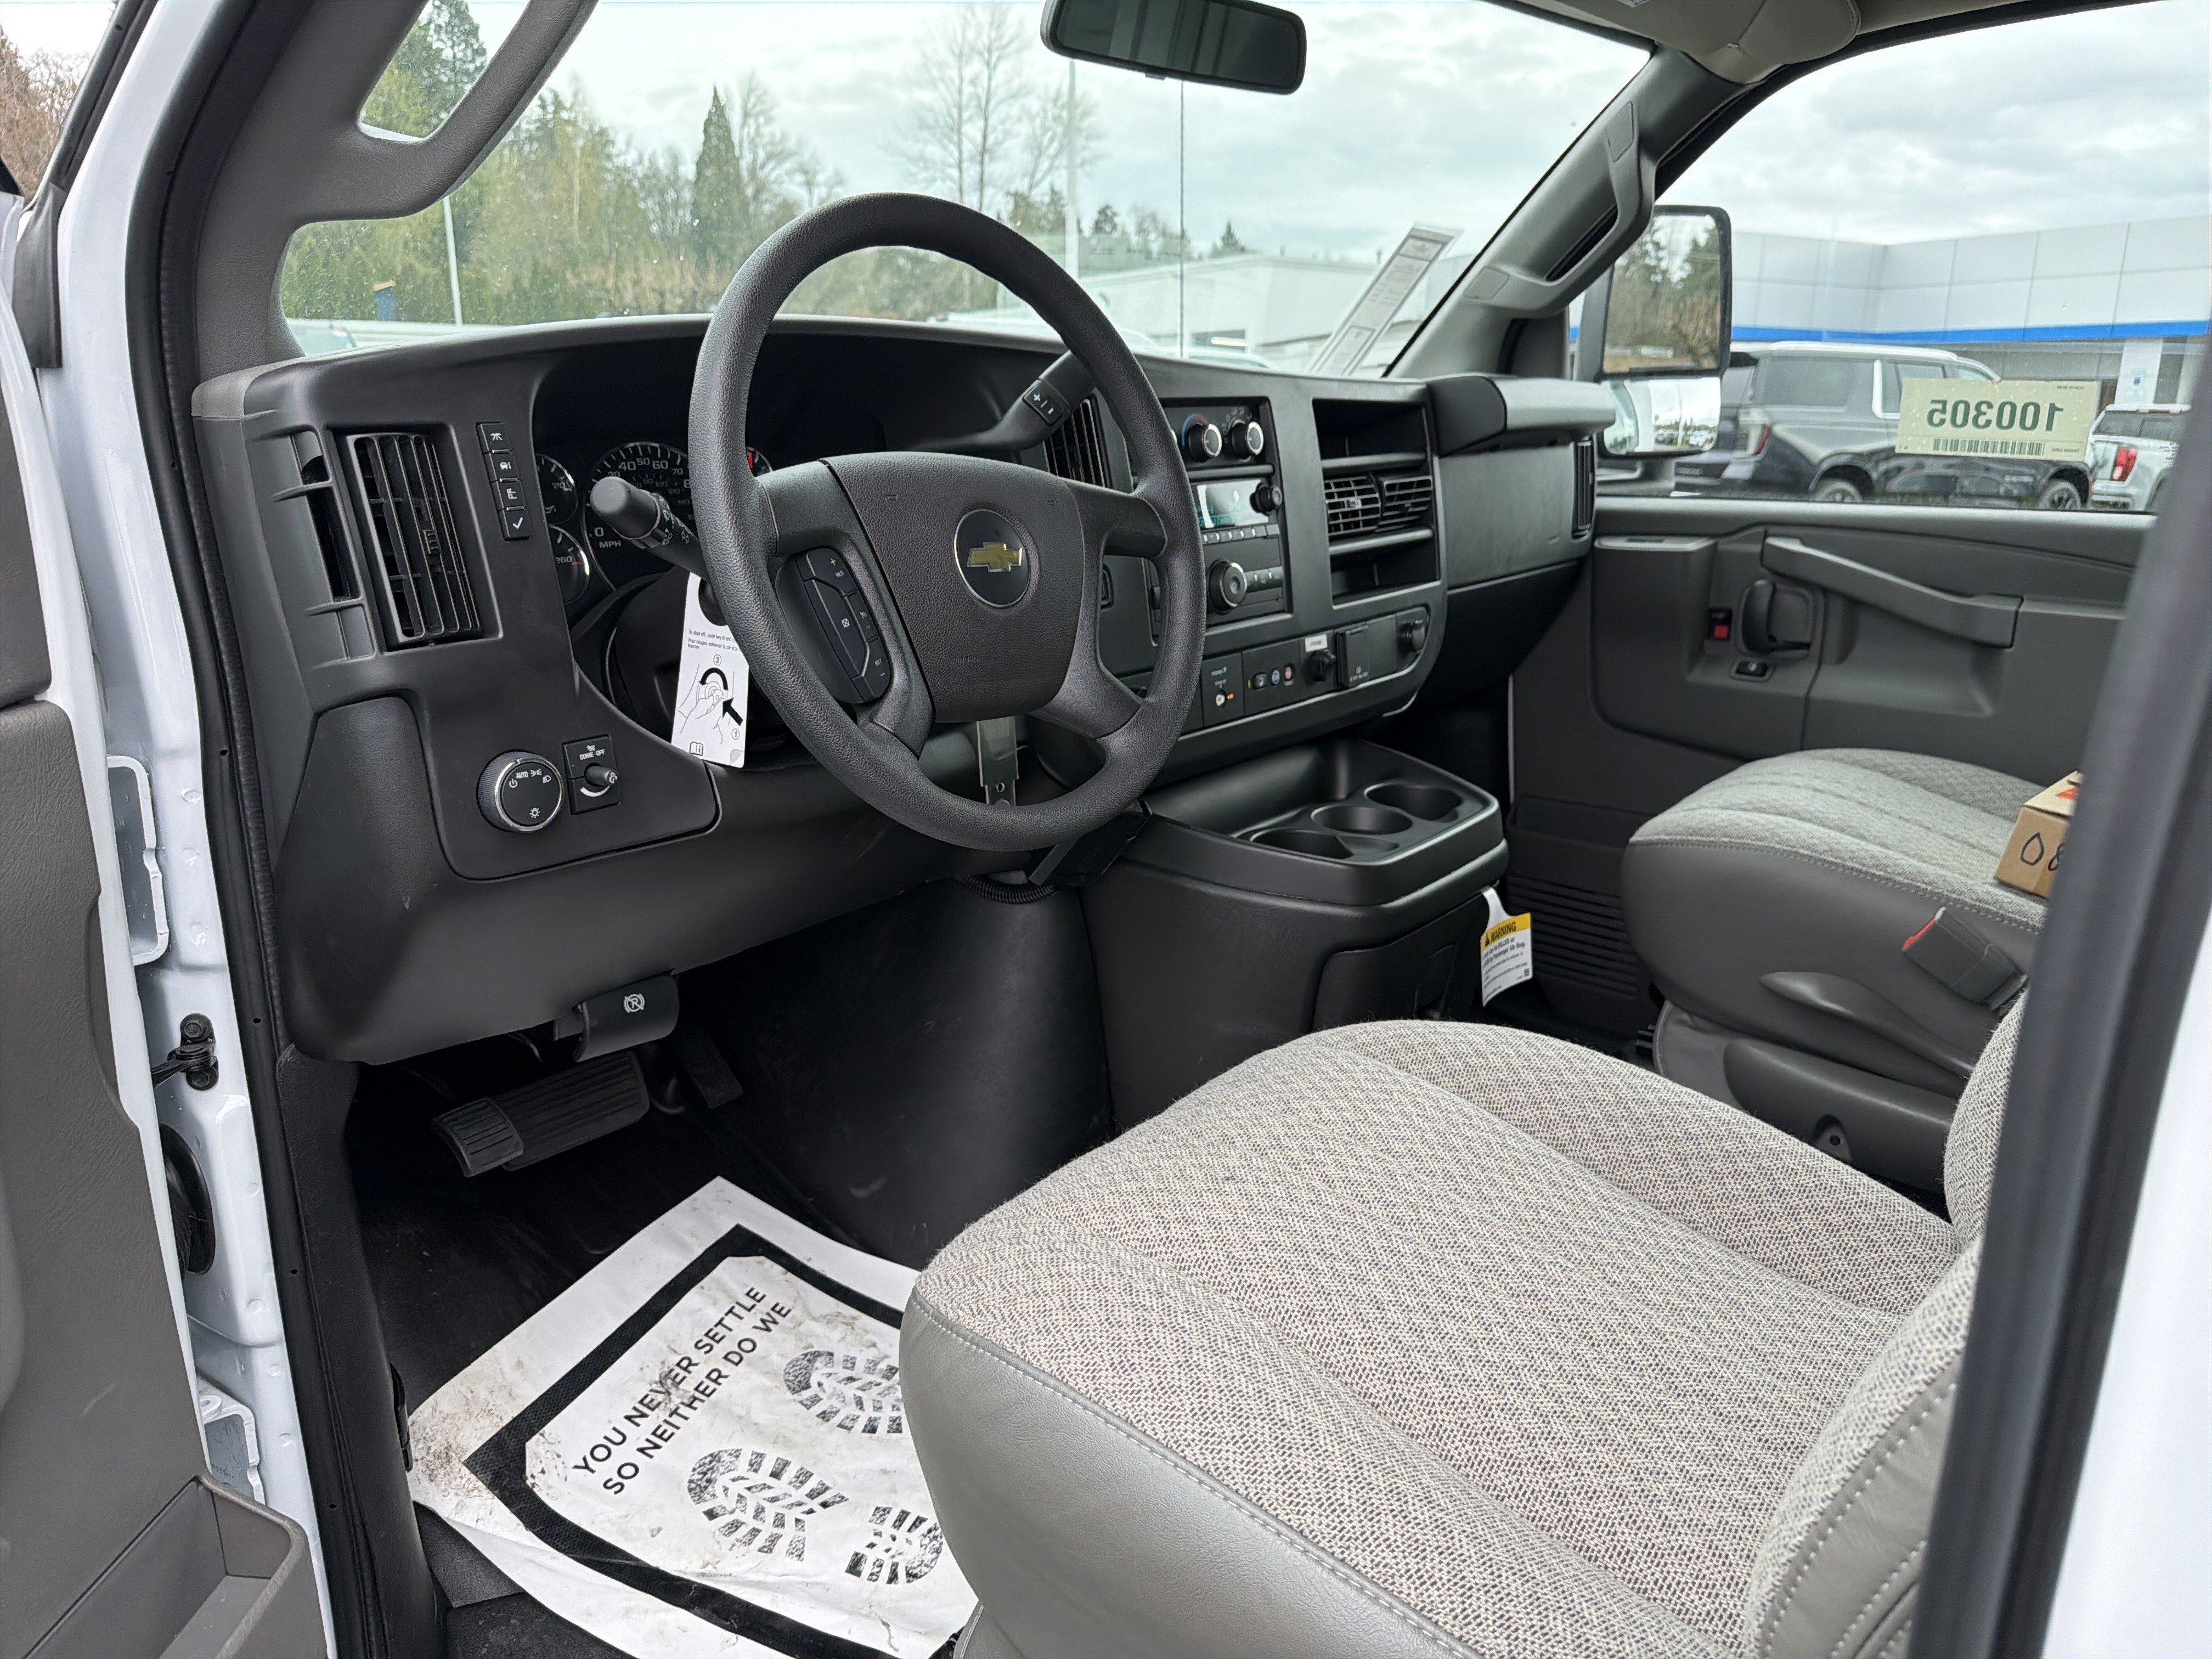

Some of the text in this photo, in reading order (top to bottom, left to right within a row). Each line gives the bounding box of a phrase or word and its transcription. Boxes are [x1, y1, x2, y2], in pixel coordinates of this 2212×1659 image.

[618, 461, 636, 471] 40
[636, 458, 650, 466] 50
[652, 460, 668, 470] 60
[672, 467, 684, 476] 70
[683, 478, 691, 489] 8
[594, 527, 604, 537] 0
[599, 540, 622, 549] MPH
[874, 658, 883, 667] SET
[579, 752, 594, 760] DOME
[516, 771, 528, 779] AUTO
[1490, 921, 1516, 943] WARNING
[1493, 947, 1509, 958] Passenger
[571, 1286, 767, 1475] YOU NEVER SETTLE
[602, 1302, 793, 1496] SO NEITHER DO WE
